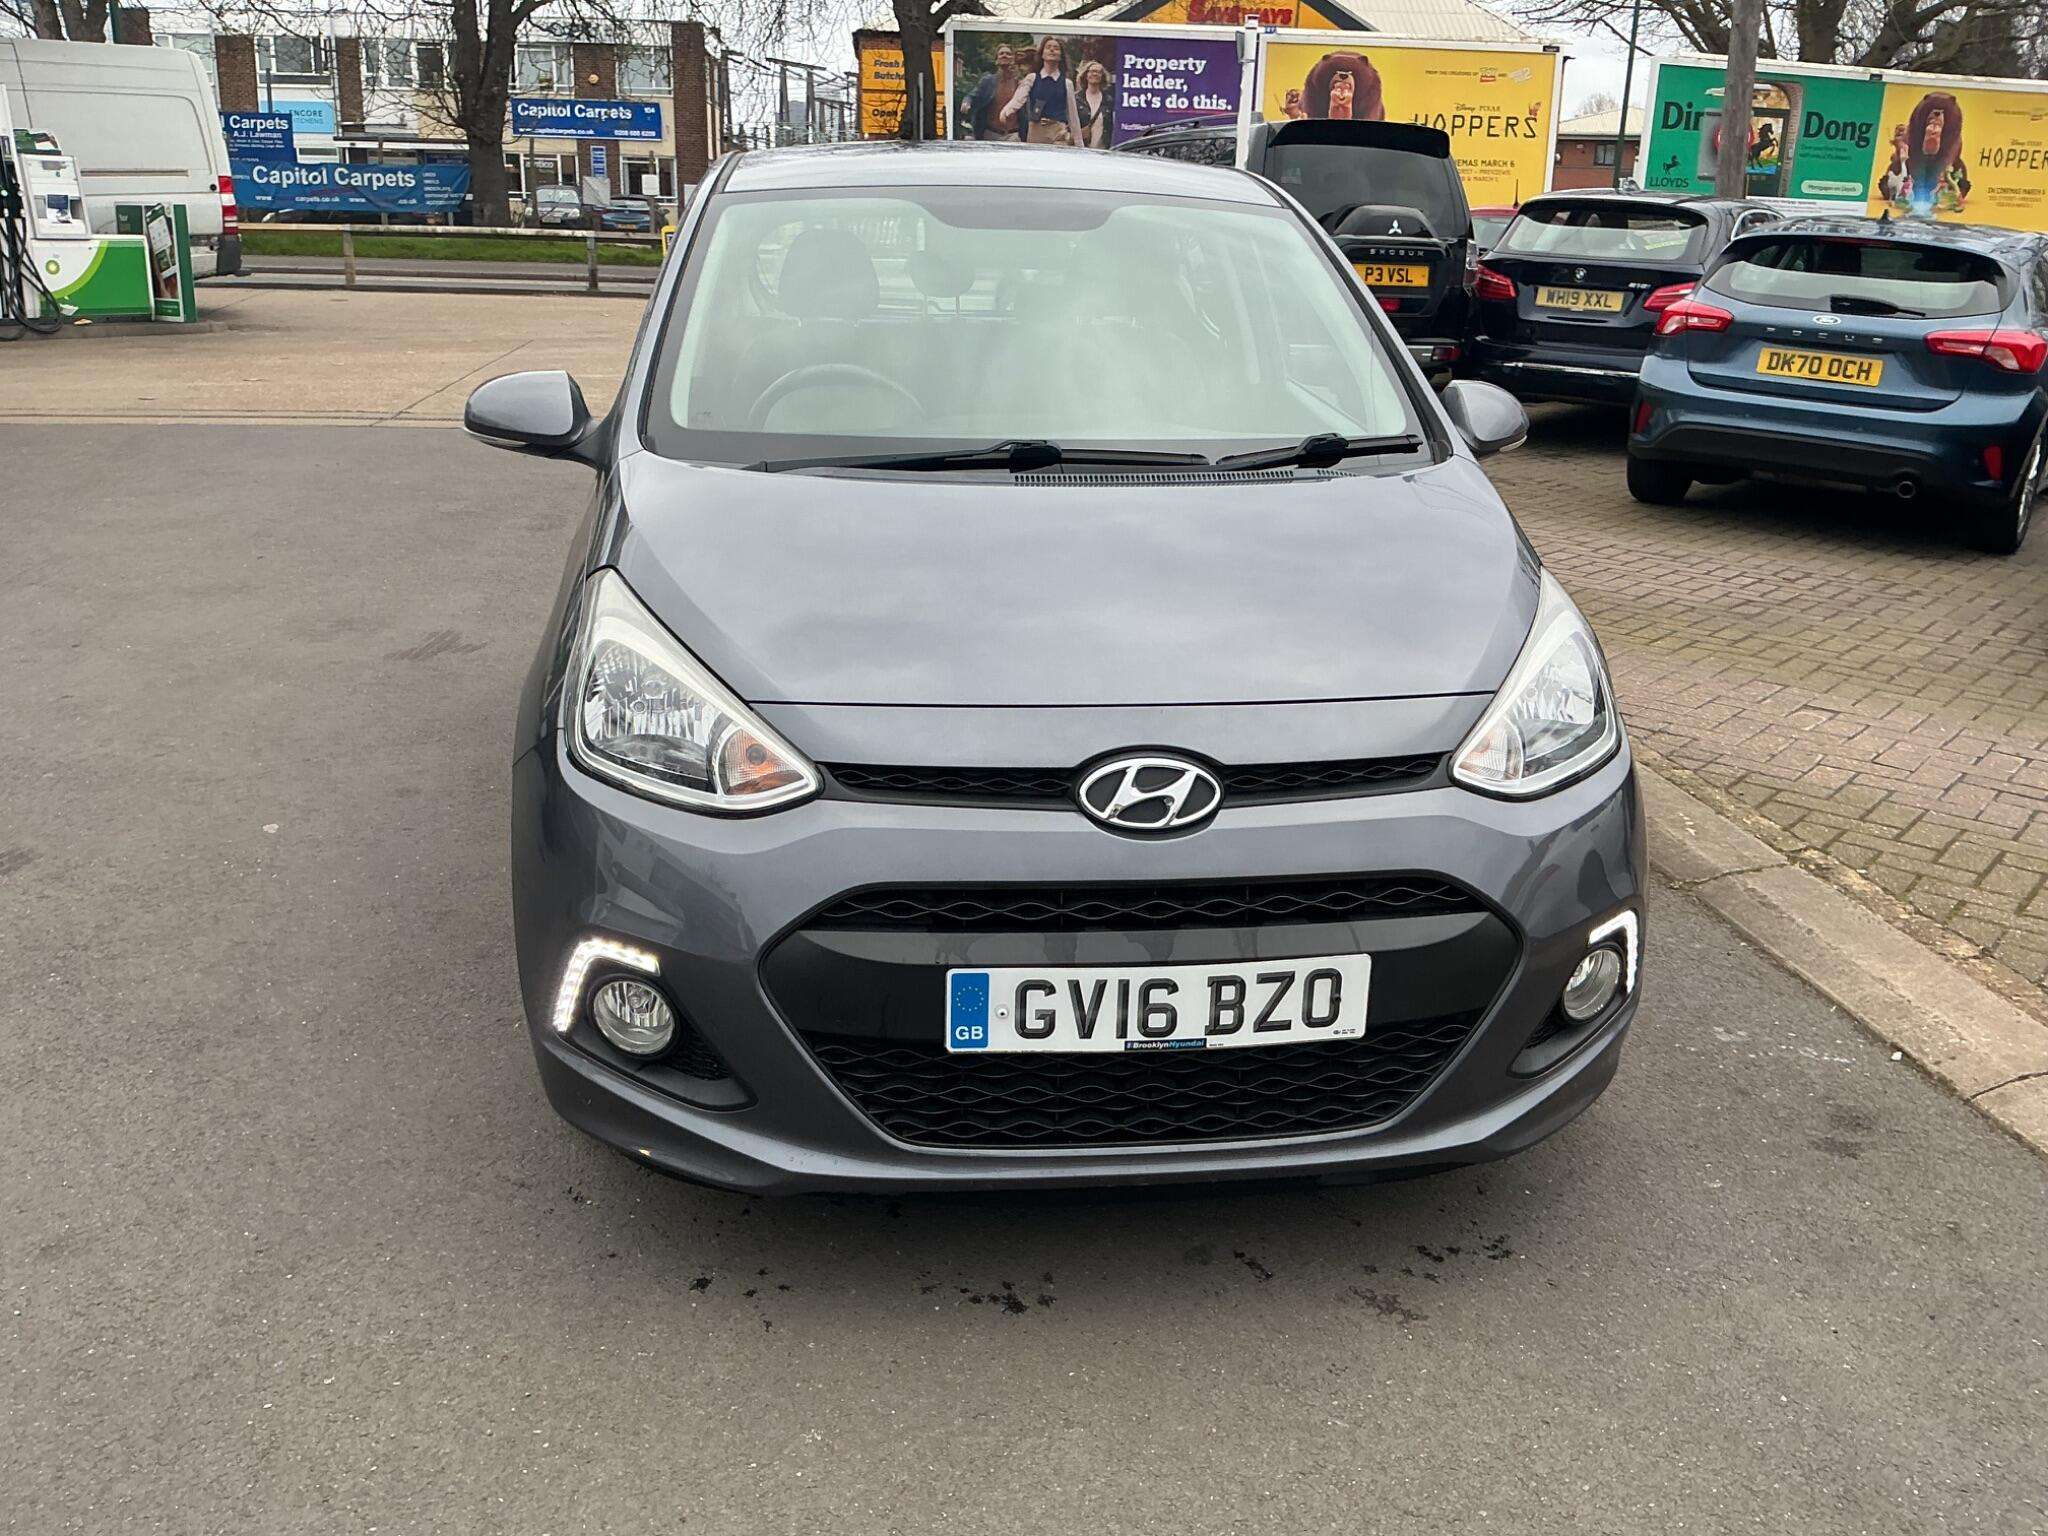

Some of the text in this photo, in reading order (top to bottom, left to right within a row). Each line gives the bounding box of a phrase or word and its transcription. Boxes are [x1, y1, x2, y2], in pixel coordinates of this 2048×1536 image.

[1123, 54, 1207, 75] Property
[874, 71, 905, 79] Butch
[1122, 73, 1189, 93] ladder,
[1121, 92, 1232, 111] let's do this.
[517, 103, 633, 122] Capitol Carpets
[229, 115, 289, 132] Carpets
[1803, 111, 1873, 149] Dong
[1481, 160, 1508, 168] MARCH
[252, 165, 416, 191] Capitol Carpets
[1649, 177, 1689, 188] LLOYDS
[1364, 267, 1414, 283] P3 VSL
[1583, 291, 1612, 308] XXL
[1766, 352, 1873, 382] DK70 OCH
[1015, 967, 1343, 1040] GV16 BZO
[955, 1026, 984, 1041] GB
